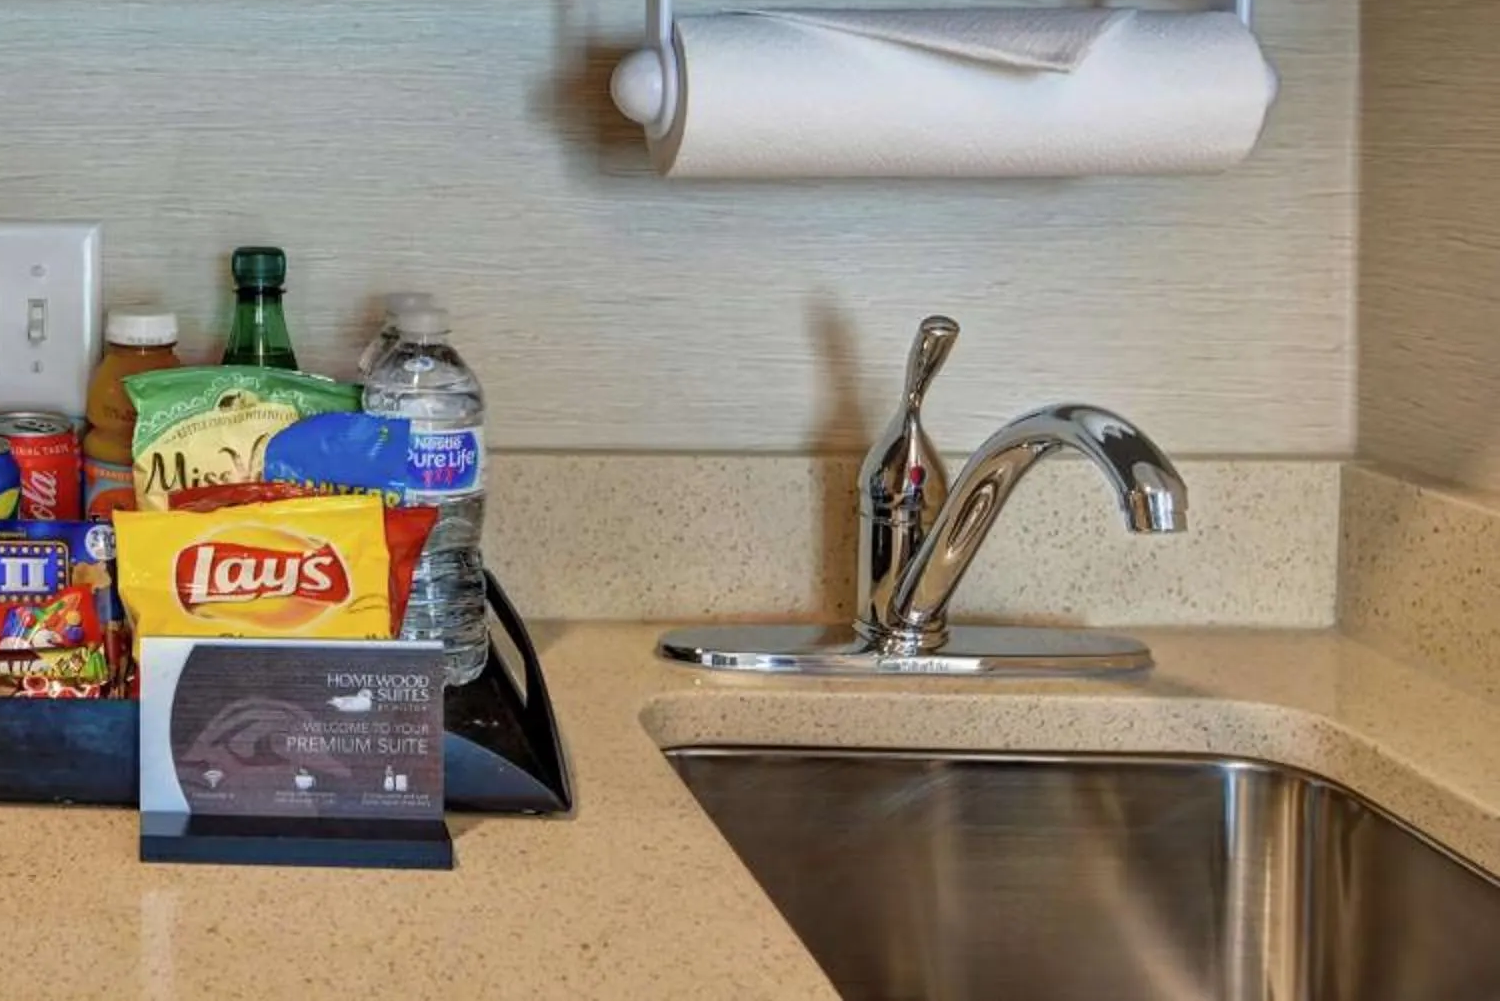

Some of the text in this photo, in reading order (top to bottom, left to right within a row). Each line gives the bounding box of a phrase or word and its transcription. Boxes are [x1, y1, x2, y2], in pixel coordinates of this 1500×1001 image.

[189, 545, 334, 604] Lay's
[327, 673, 430, 688] HOMEWOOD
[377, 688, 430, 702] SUITES
[303, 722, 430, 736] WELCOME TO YOUR
[286, 736, 428, 755] PREMIUM SUITE
